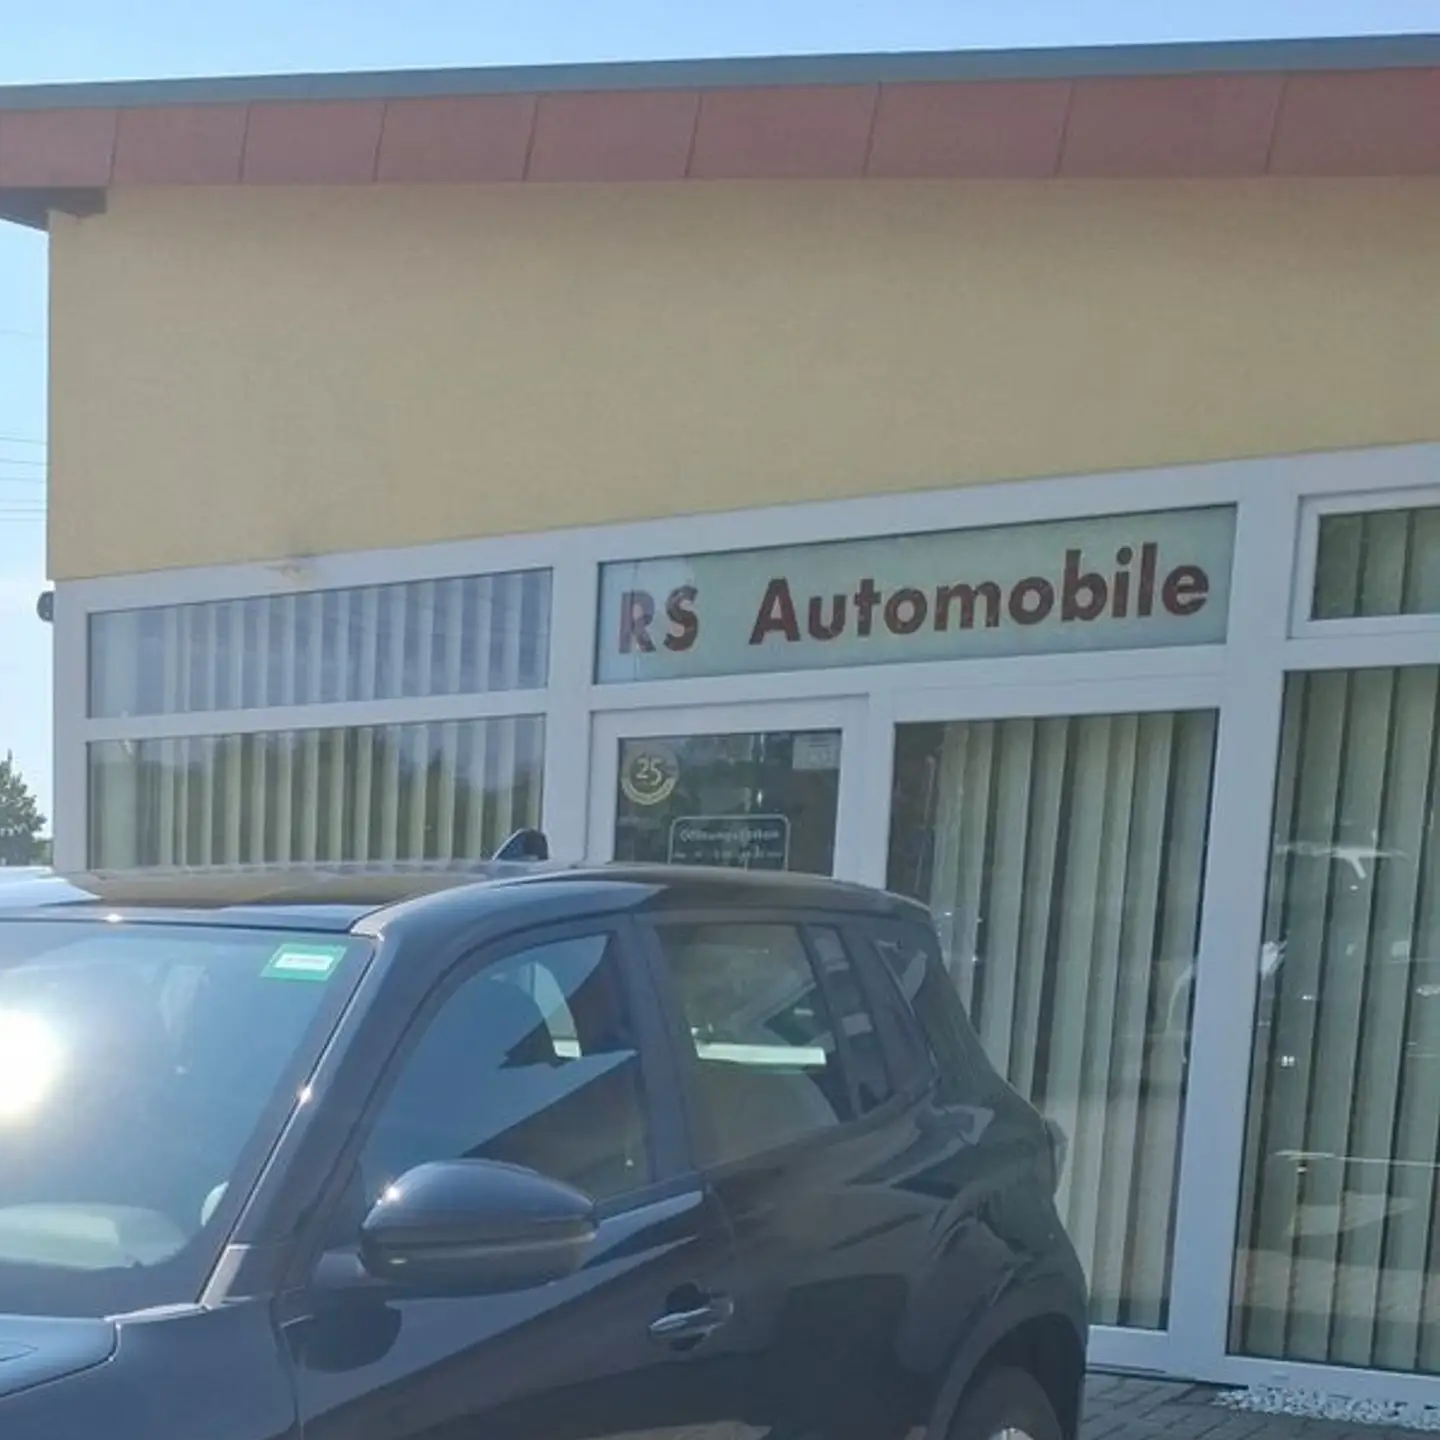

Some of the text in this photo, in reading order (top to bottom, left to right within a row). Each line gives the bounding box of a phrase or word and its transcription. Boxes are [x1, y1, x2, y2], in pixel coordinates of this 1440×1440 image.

[618, 541, 1210, 654] RS Automobile
[635, 758, 662, 786] 25
